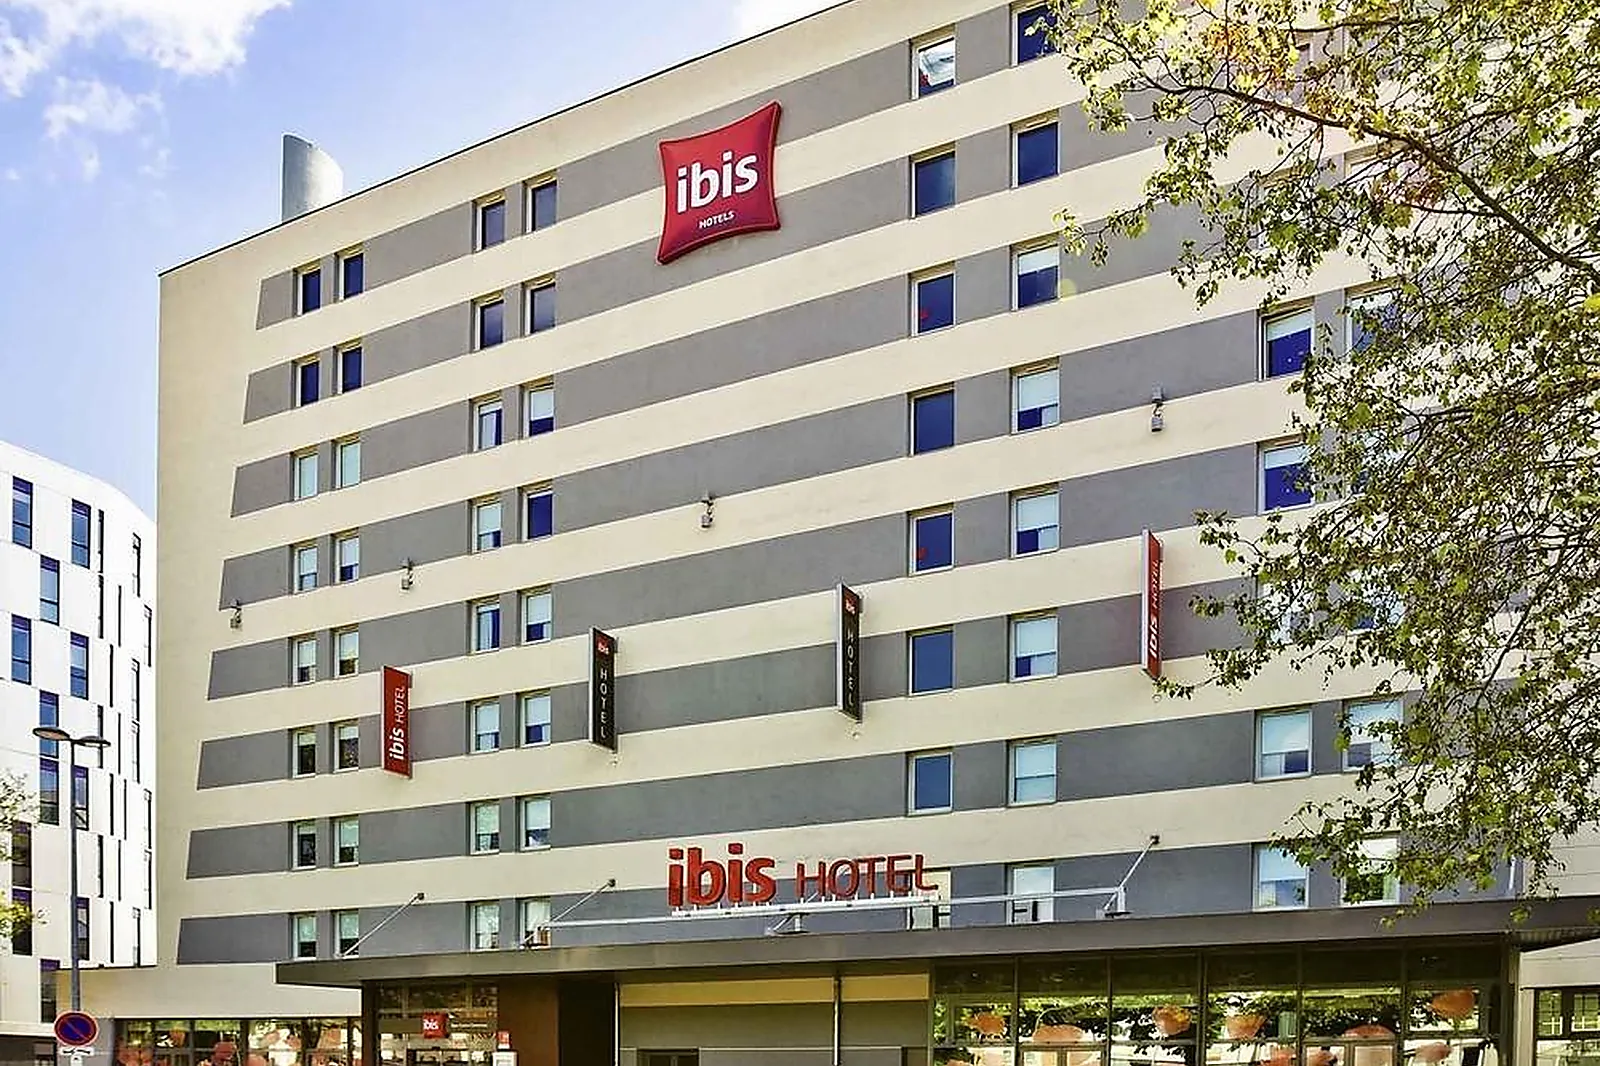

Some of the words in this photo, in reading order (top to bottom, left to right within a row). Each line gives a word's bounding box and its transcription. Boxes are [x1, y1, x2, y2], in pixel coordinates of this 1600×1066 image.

[677, 151, 758, 213] ibis
[699, 210, 735, 229] HOTELS
[1149, 614, 1158, 658] ibis
[394, 685, 406, 724] HOTEL
[600, 667, 608, 738] HOTEL
[389, 727, 405, 760] ibis
[668, 843, 777, 907] ibis
[796, 854, 938, 899] HOTEL
